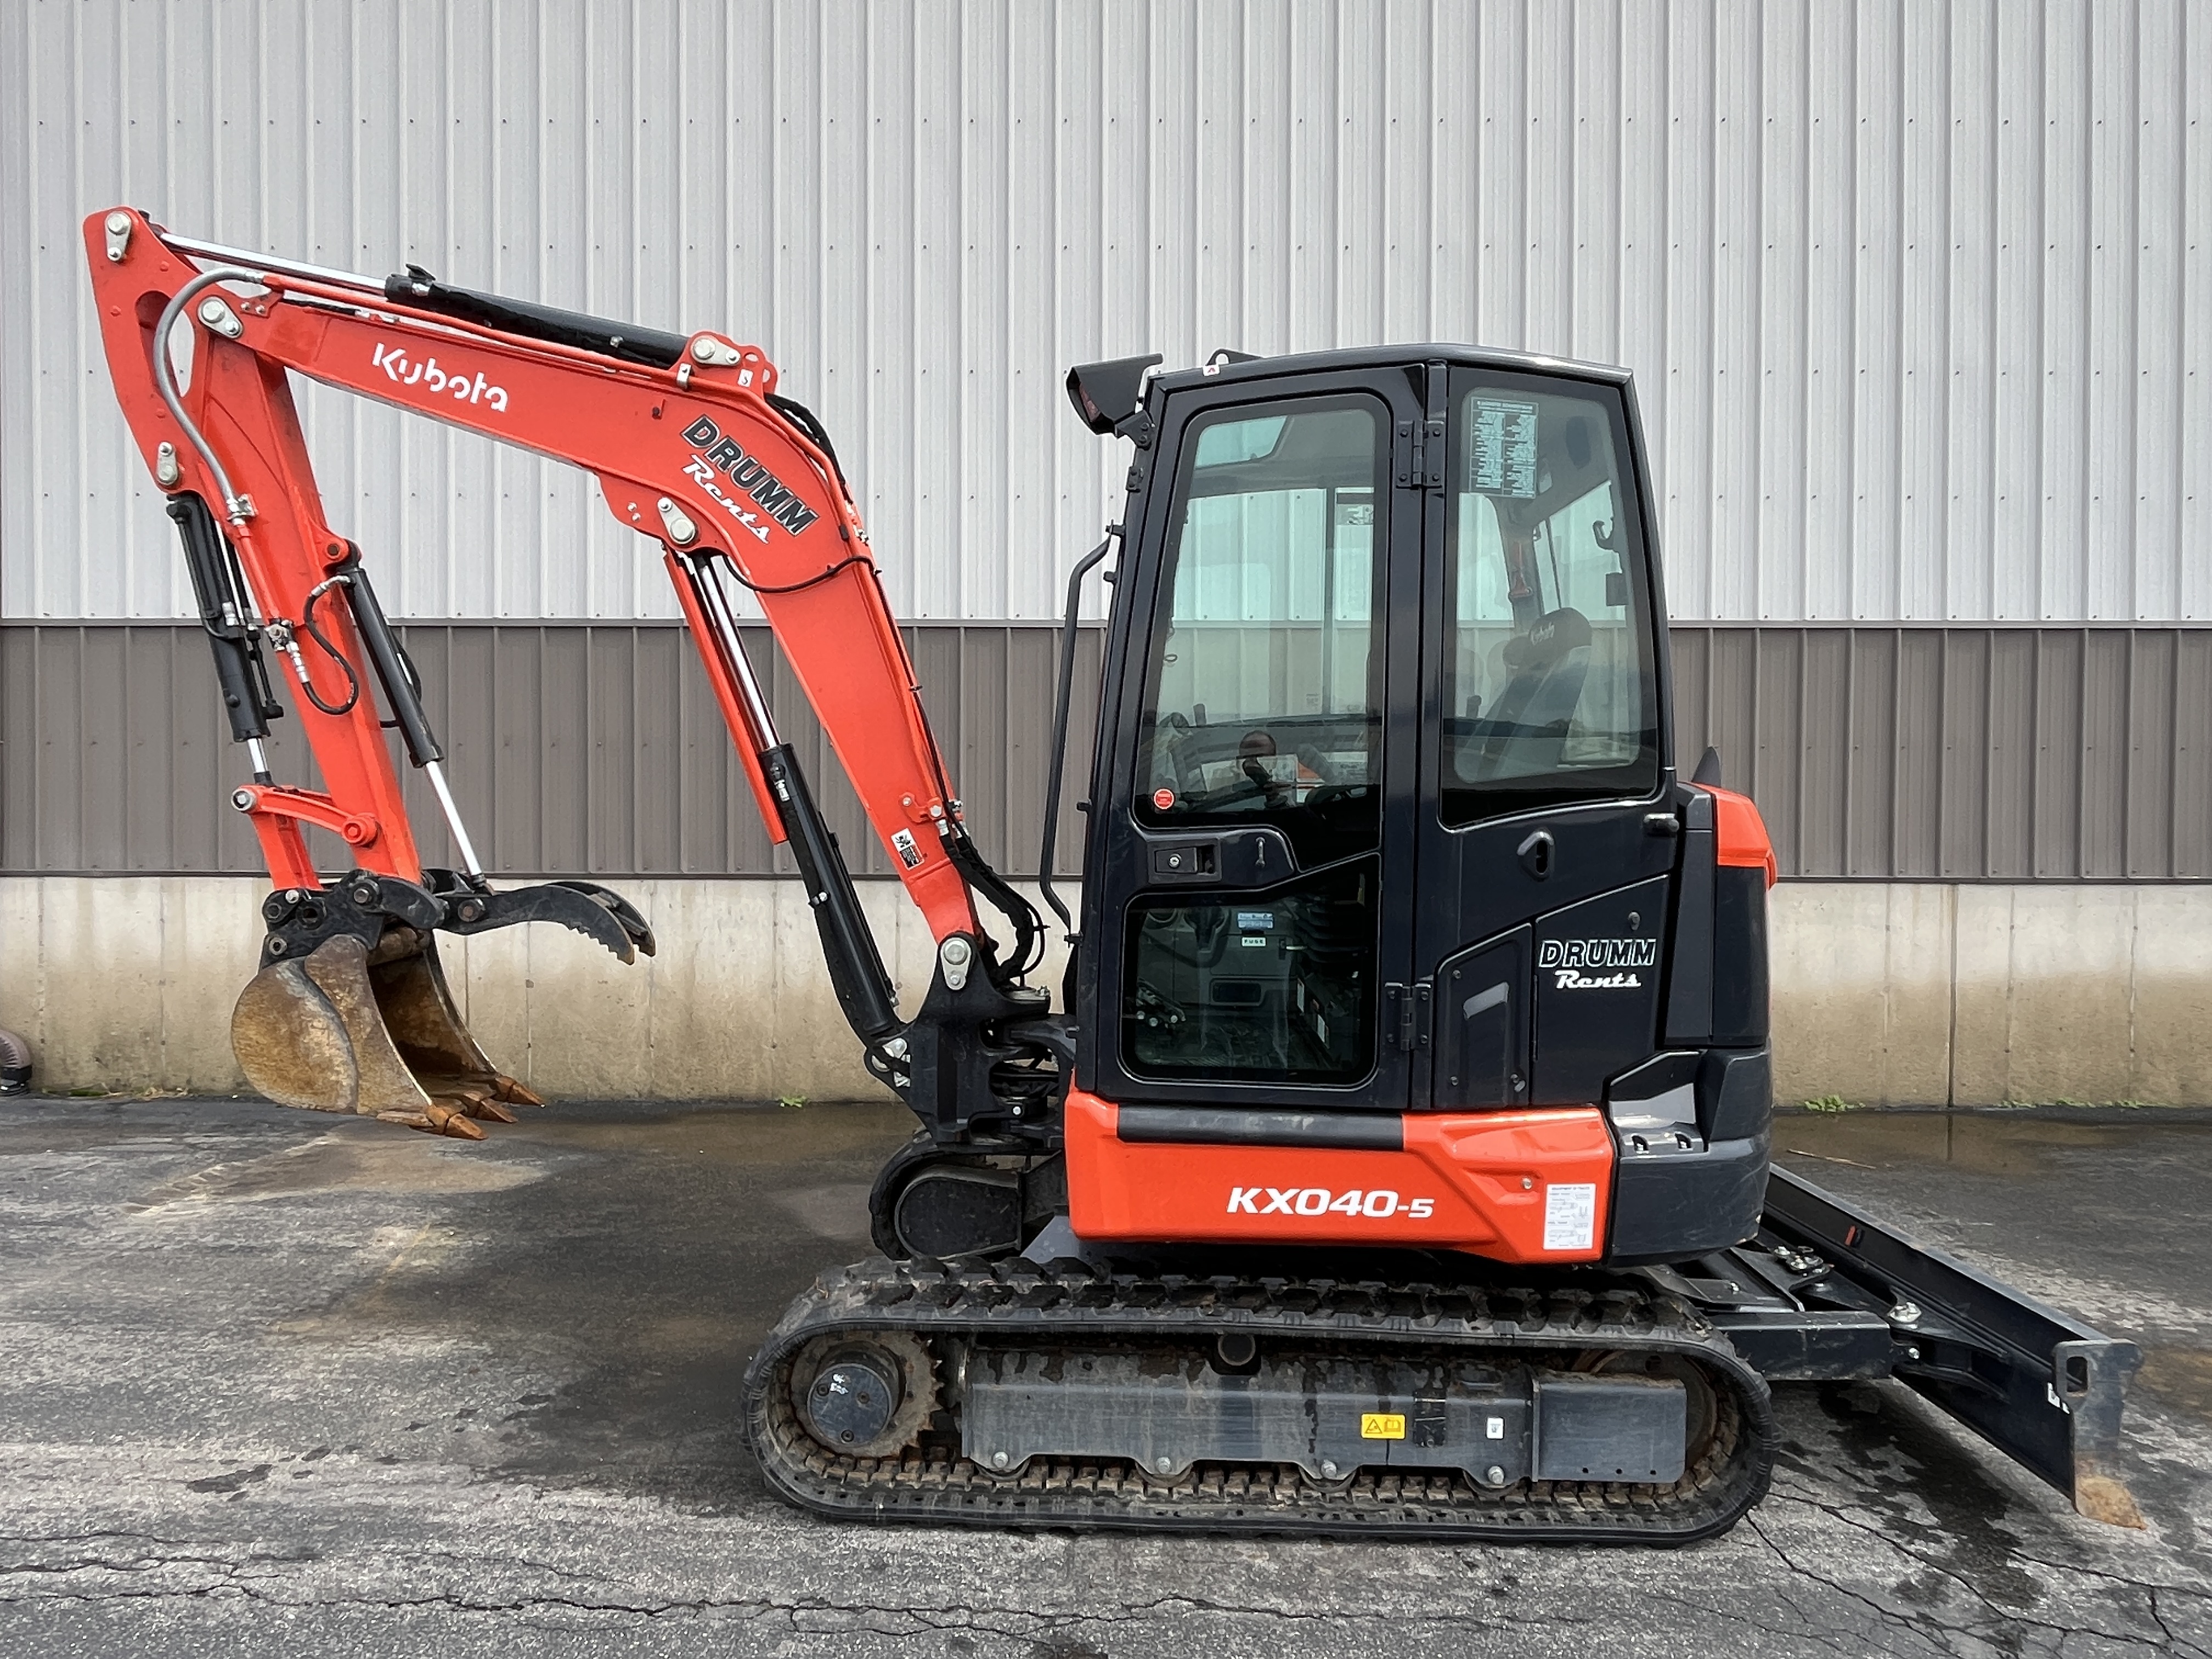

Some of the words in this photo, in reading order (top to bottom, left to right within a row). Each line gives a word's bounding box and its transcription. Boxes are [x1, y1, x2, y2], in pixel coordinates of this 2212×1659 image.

[372, 342, 508, 412] Kubota
[680, 414, 820, 536] DRUMM
[682, 453, 770, 544] Rents
[1539, 939, 1656, 967] DRUMM
[1554, 969, 1641, 989] Rents
[1227, 1187, 1435, 1218] KX040-5
